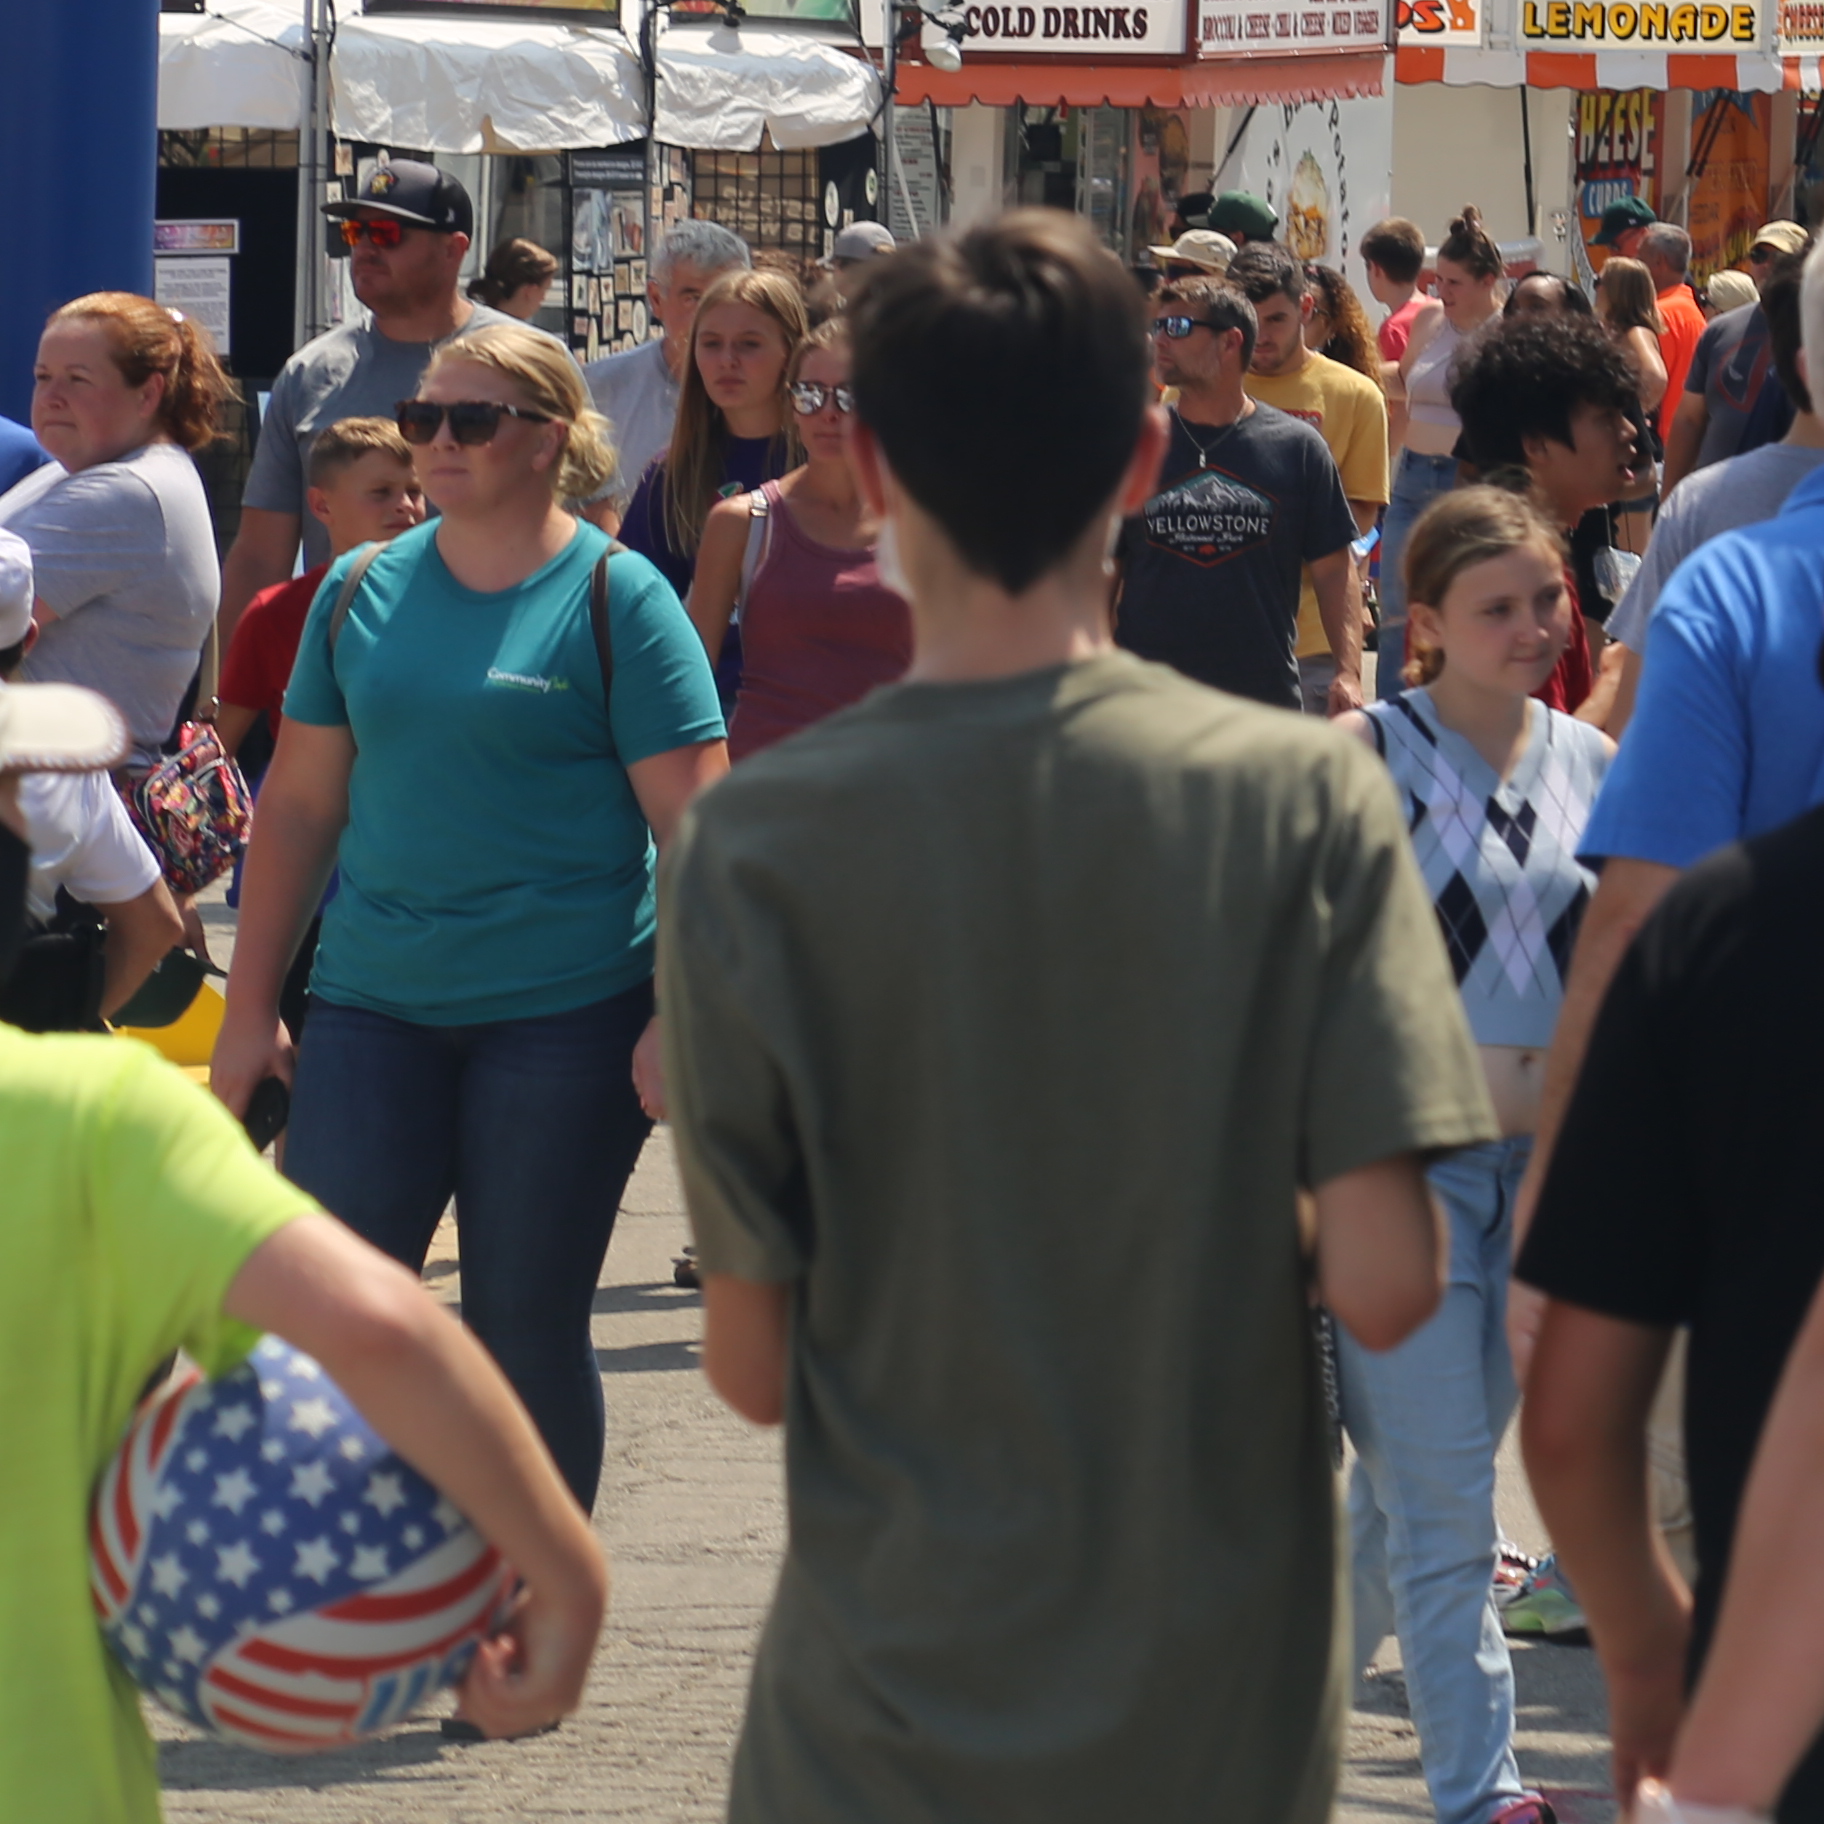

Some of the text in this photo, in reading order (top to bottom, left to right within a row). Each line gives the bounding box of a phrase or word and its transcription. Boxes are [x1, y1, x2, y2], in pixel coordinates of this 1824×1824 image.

[964, 7, 1148, 39] COLD DRINKS
[1522, 2, 1755, 43] LEMONADE
[1146, 514, 1270, 535] YELLOWSTONE
[487, 666, 551, 694] Community
